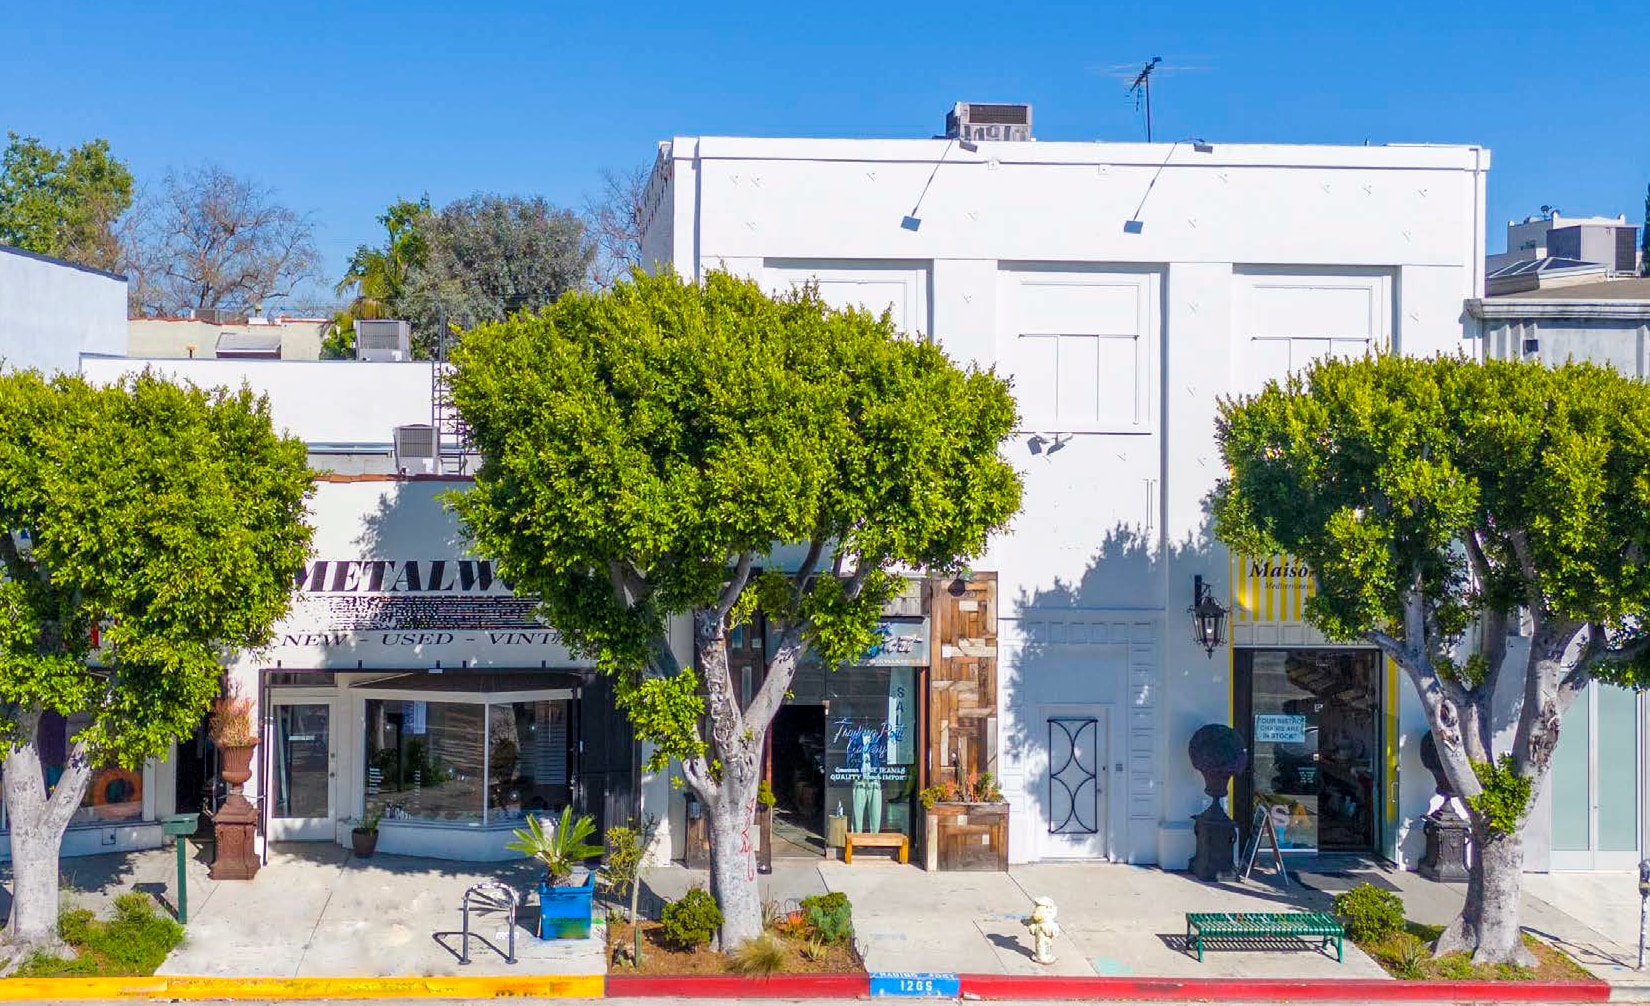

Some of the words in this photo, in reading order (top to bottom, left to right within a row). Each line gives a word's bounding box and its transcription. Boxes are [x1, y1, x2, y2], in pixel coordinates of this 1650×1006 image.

[294, 560, 516, 592] METALW
[1248, 561, 1312, 578] Maiso
[281, 634, 347, 646] NEW
[381, 633, 454, 645] USED
[830, 773, 861, 781] QUALITY
